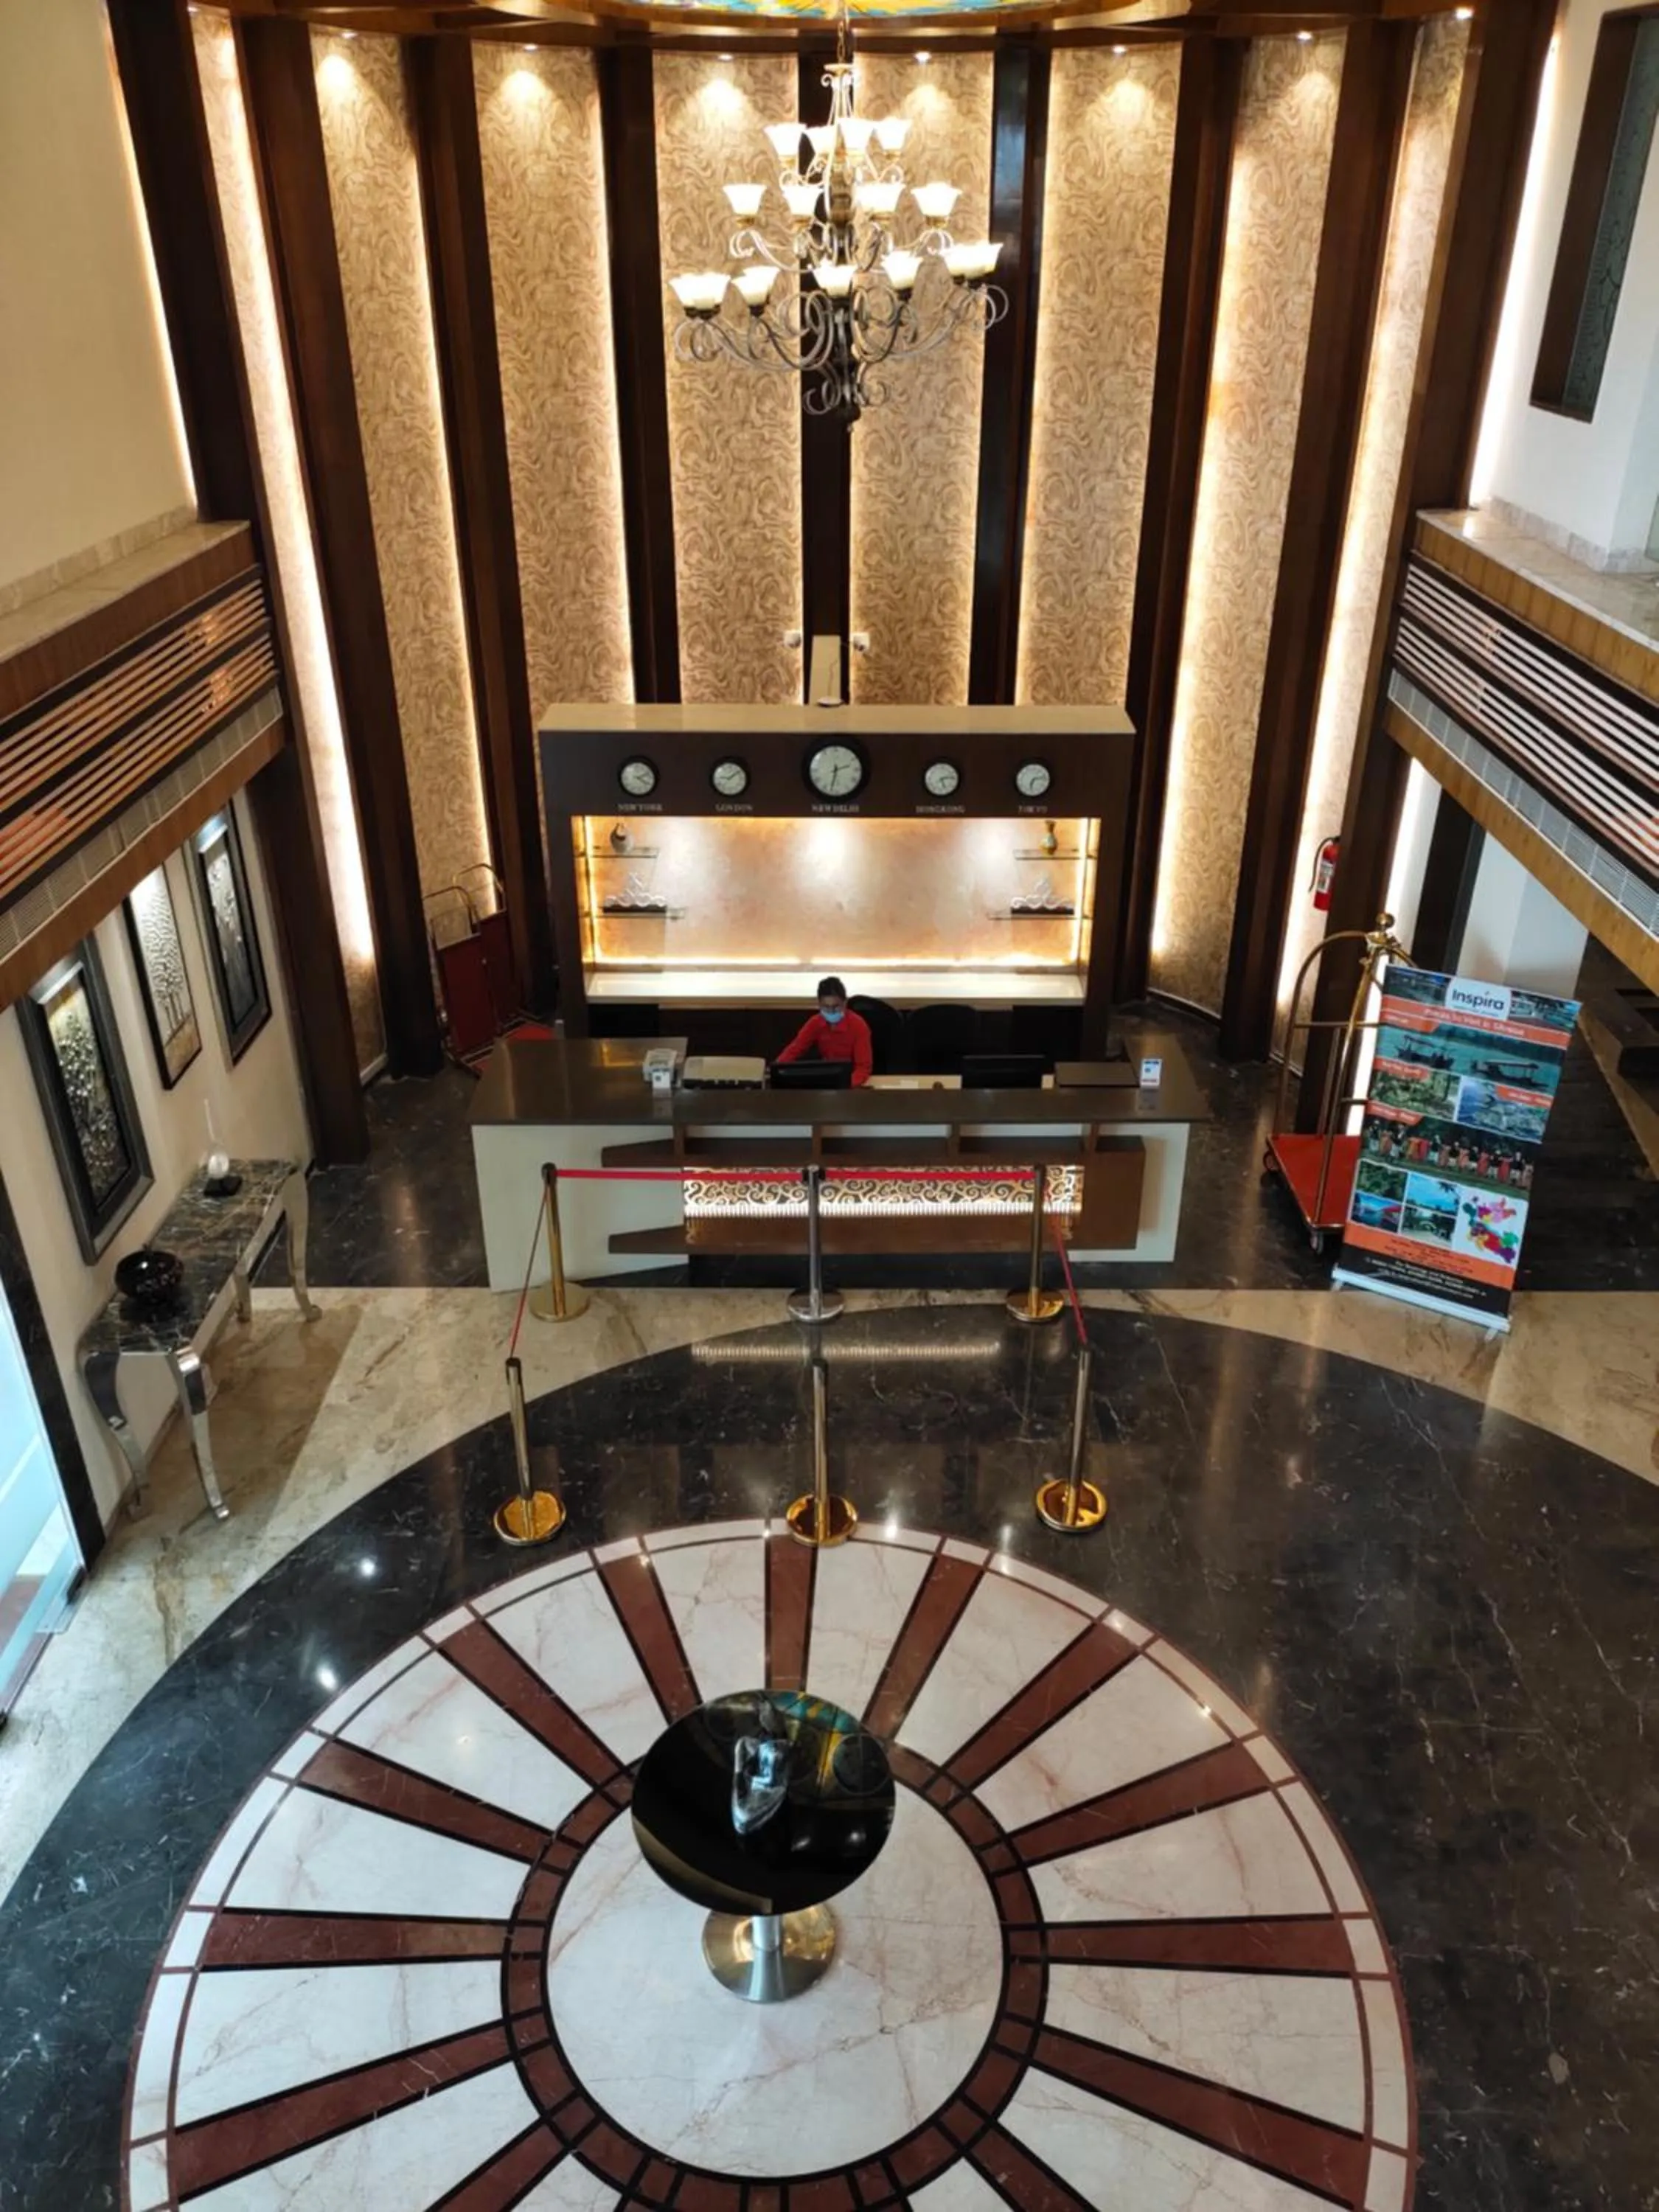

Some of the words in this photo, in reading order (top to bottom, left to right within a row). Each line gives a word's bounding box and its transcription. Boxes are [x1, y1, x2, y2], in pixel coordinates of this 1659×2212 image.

[714, 804, 753, 813] LONDON
[811, 804, 831, 813] NEW
[832, 804, 860, 813] DELHI
[1451, 989, 1505, 1011] Inspira
